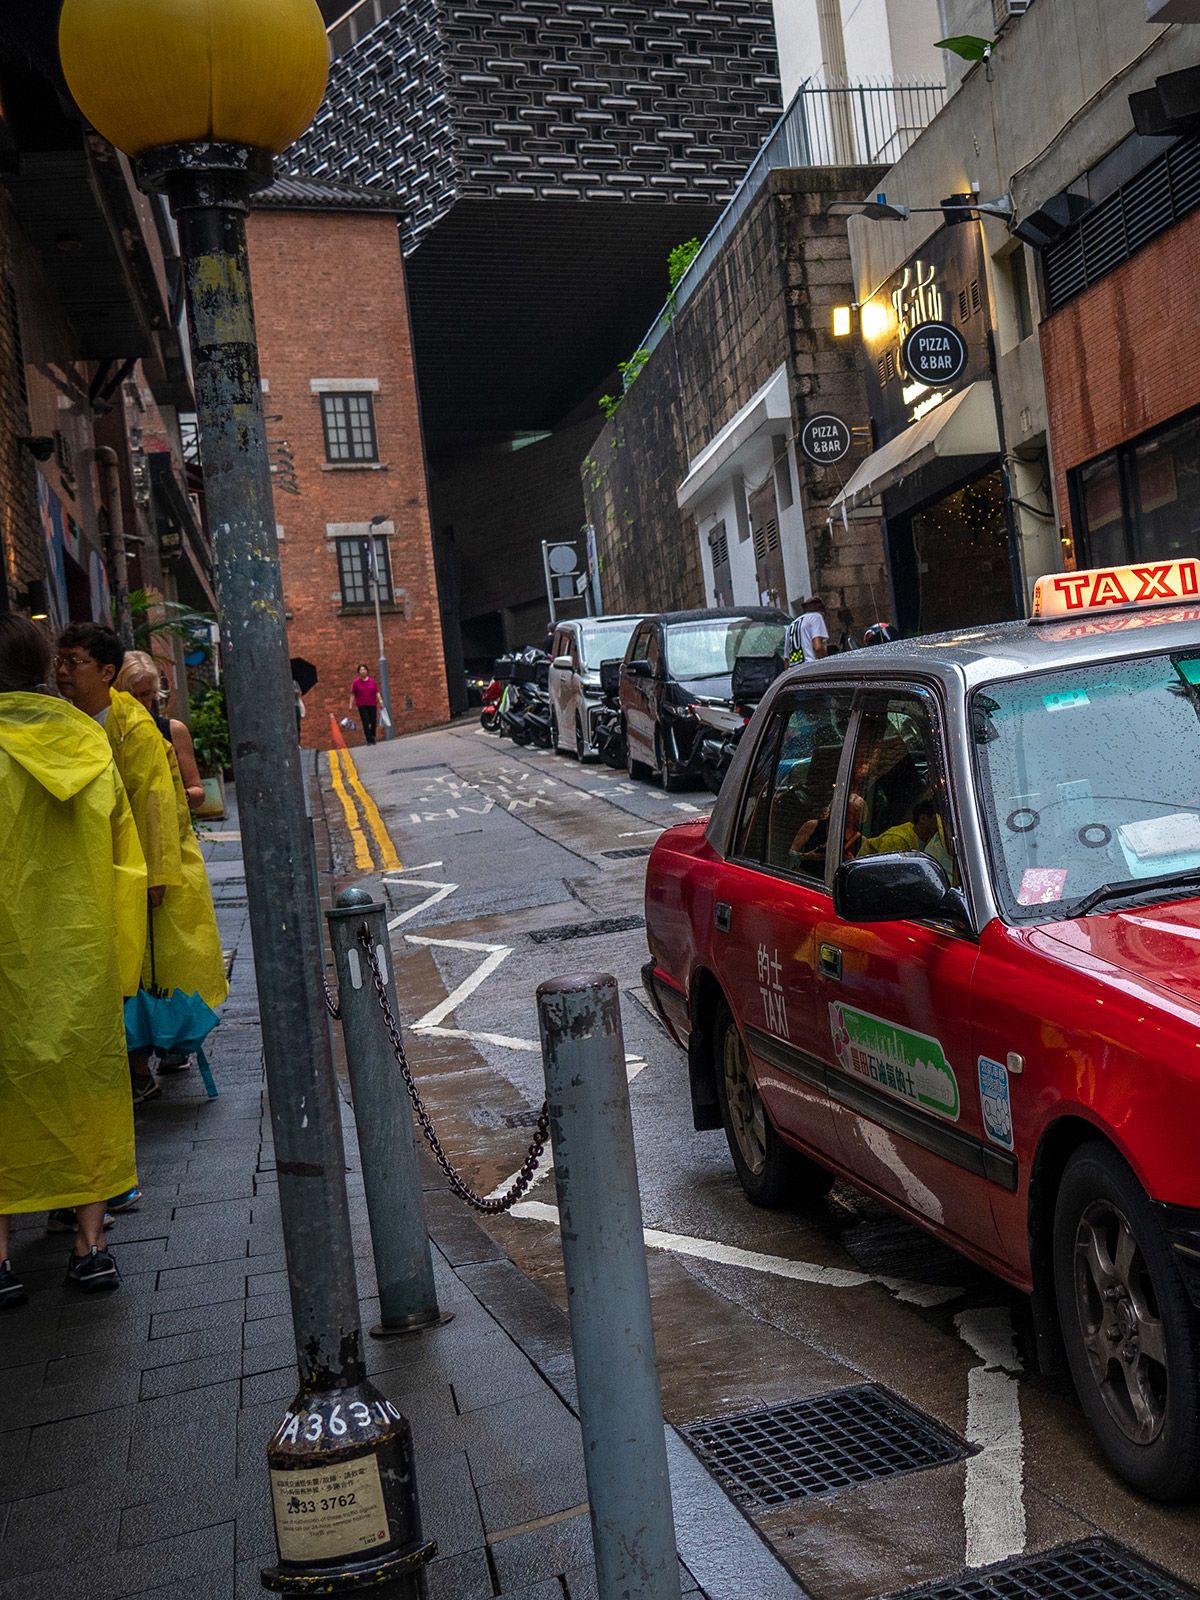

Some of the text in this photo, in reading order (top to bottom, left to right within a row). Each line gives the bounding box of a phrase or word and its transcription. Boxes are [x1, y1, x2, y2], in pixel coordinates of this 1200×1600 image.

[918, 337, 951, 352] PIZZA
[920, 354, 953, 370] &BAR
[811, 425, 839, 439] PIZZA
[813, 440, 841, 453] &BAR
[1054, 562, 1199, 610] TAXI
[757, 943, 783, 991] 的士
[759, 986, 790, 1039] TAXI
[320, 1492, 357, 1511] 3762
